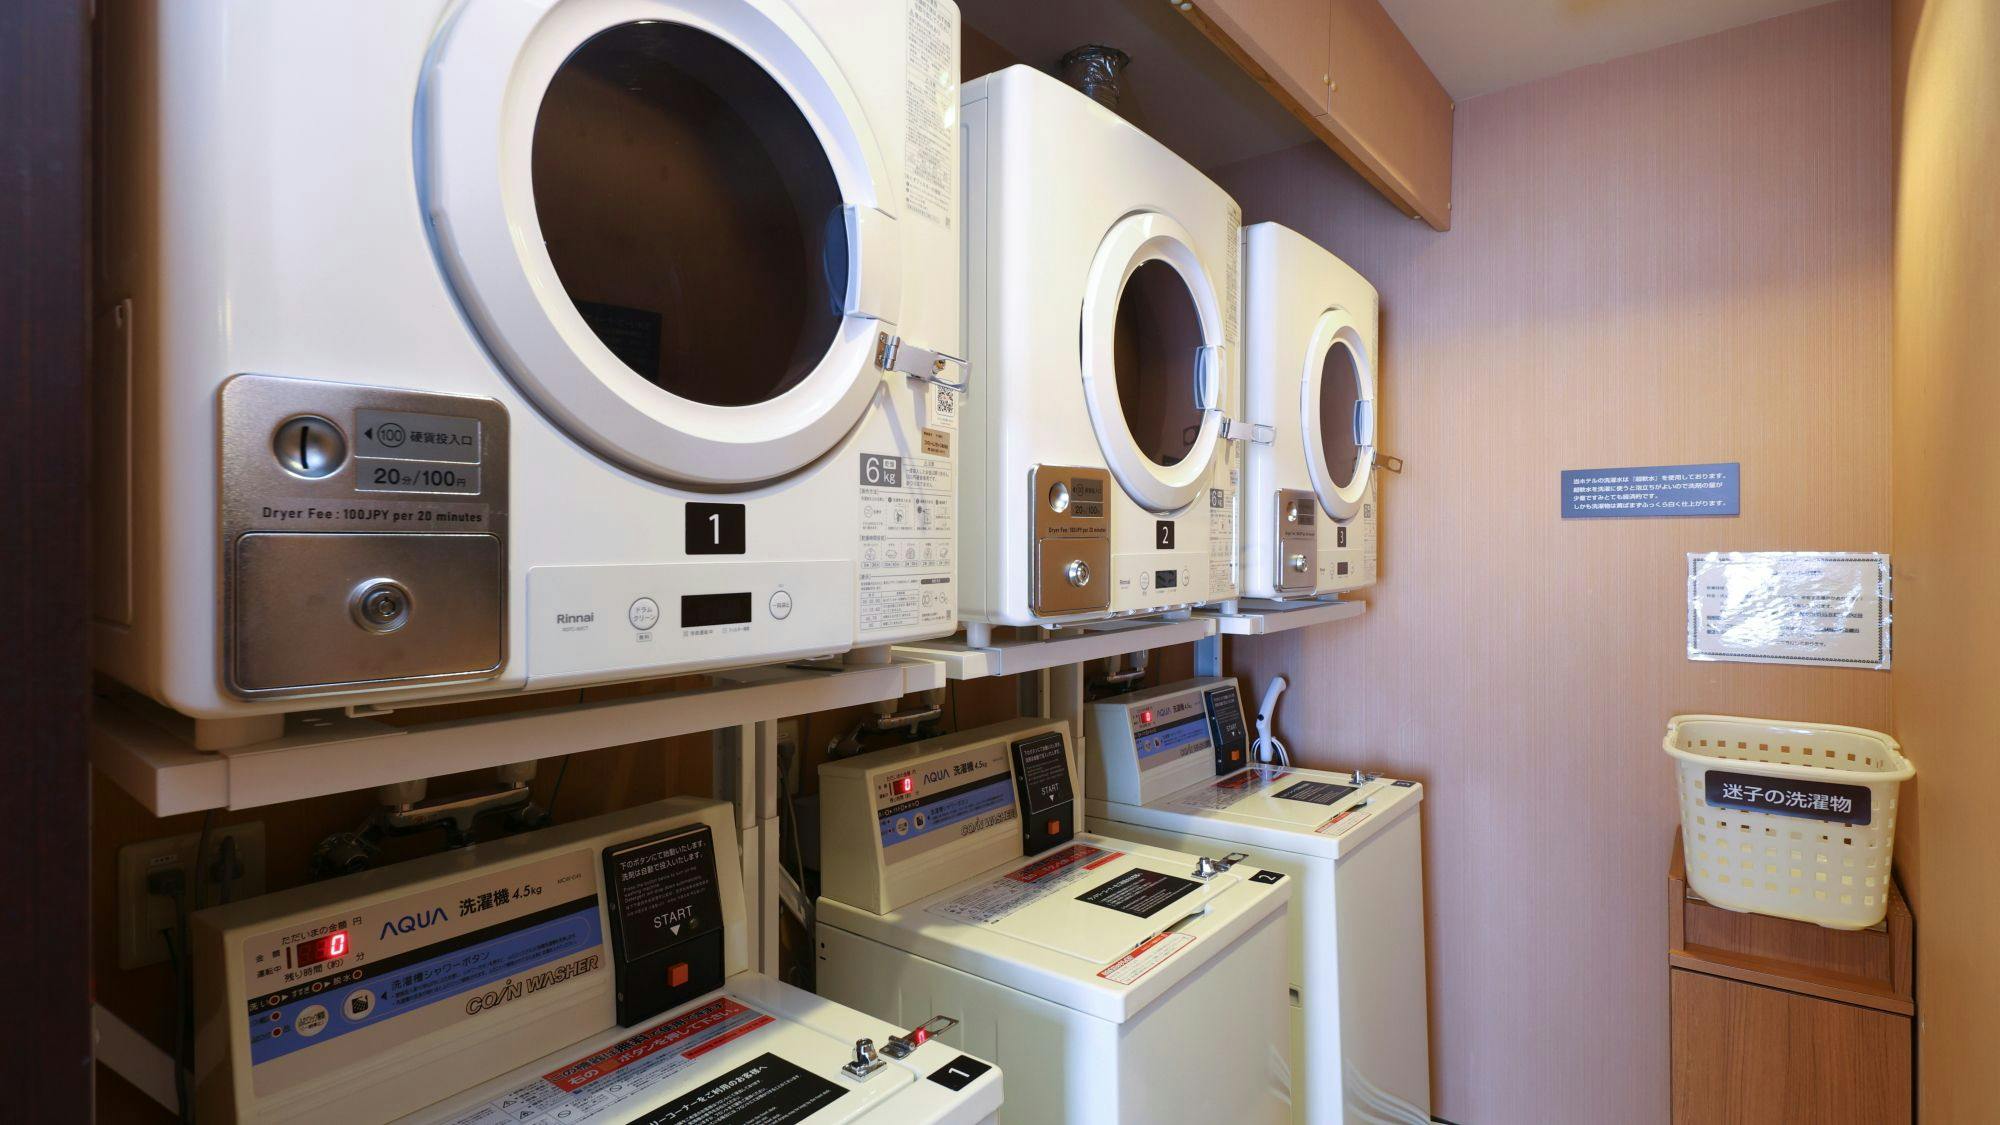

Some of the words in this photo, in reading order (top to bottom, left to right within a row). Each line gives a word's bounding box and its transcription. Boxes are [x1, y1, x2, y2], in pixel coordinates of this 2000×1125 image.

[410, 431, 473, 447] 硬貨投入口
[373, 468, 467, 488] 20分/100円
[866, 457, 880, 483] 6
[884, 471, 896, 485] kg
[262, 506, 303, 521] Dryer
[343, 508, 389, 521] 100JPY
[392, 511, 414, 524] per
[417, 510, 433, 522] 20
[436, 511, 483, 523] minutes
[709, 513, 721, 546] 1
[1162, 526, 1169, 545] 2
[1340, 530, 1344, 544] 3
[557, 612, 595, 624] Rinnai
[633, 614, 656, 623] クリーン
[635, 606, 653, 614] ドラム
[923, 769, 950, 785] AQUA
[953, 760, 975, 776] 洗濯機
[904, 778, 911, 791] 0
[1041, 782, 1060, 796] START
[1722, 782, 1852, 814] 迷子の洗濯物
[379, 907, 449, 941] AQUA
[459, 887, 510, 917] 洗濯機
[511, 884, 543, 900] 4.5kg
[653, 905, 693, 929] START
[282, 921, 347, 945] ただいまの金額
[352, 916, 362, 926] 円
[330, 933, 345, 955] 0
[356, 952, 365, 961] 分
[391, 951, 490, 991] 洗濯槽シャワーボタン
[526, 954, 599, 992] WASHER
[568, 1069, 600, 1086] 右の
[619, 1008, 740, 1063] ボタンを押して下さい。
[946, 1065, 971, 1078] 1
